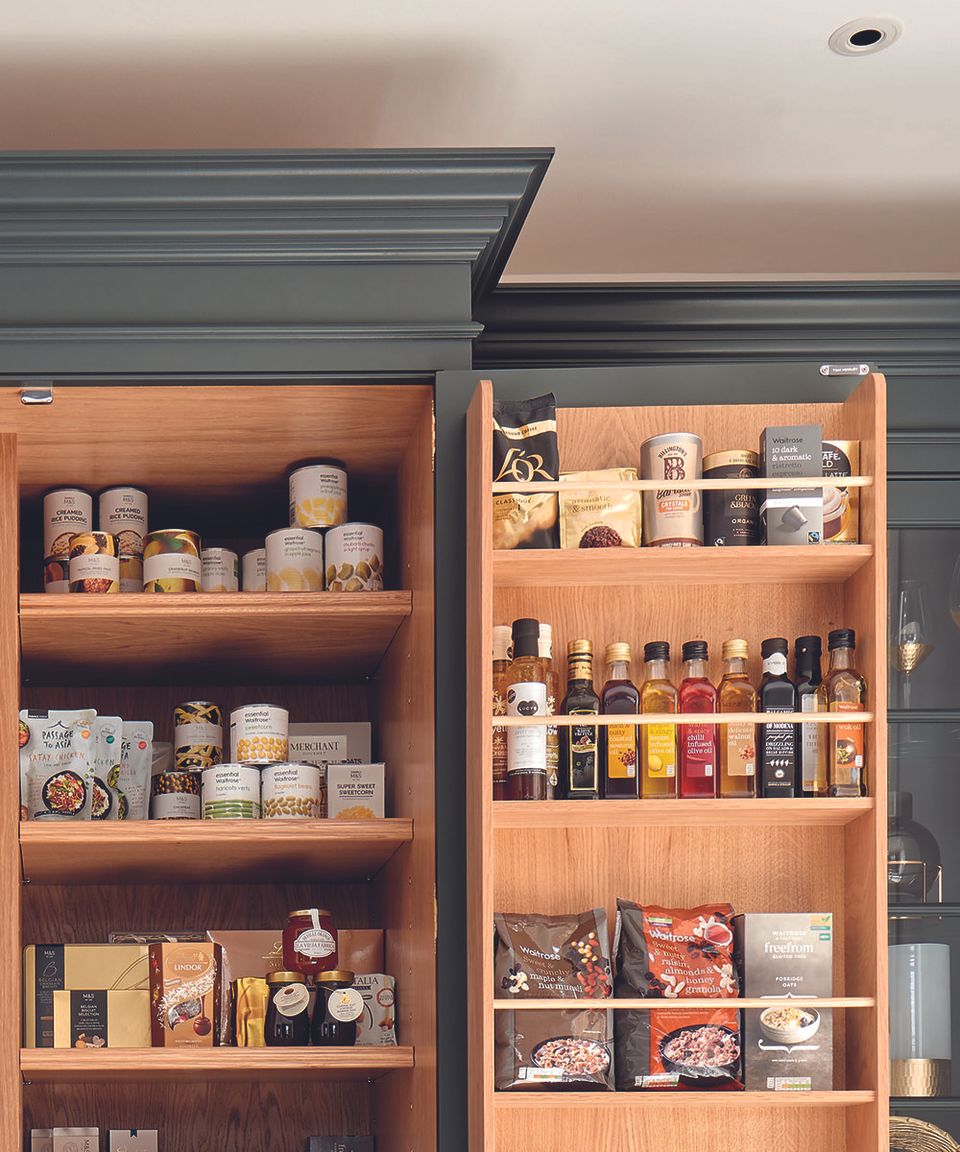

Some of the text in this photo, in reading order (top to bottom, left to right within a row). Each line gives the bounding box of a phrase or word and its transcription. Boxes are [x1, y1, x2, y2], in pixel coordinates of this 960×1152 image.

[779, 453, 811, 461] aromatic
[581, 504, 613, 512] smooth
[42, 730, 73, 739] PASSAGE
[290, 742, 339, 750] MERCHANT
[29, 752, 85, 761] SATAY CHICKEN
[649, 929, 696, 943] Waitrose
[764, 942, 813, 953] freefrom
[519, 945, 560, 960] Waitrose
[663, 952, 685, 960] nutty
[536, 967, 570, 976] crunchy
[665, 967, 706, 976] almonds
[529, 973, 556, 982] maple
[686, 977, 714, 986] honey
[555, 983, 583, 992] muesli
[685, 985, 721, 994] granola
